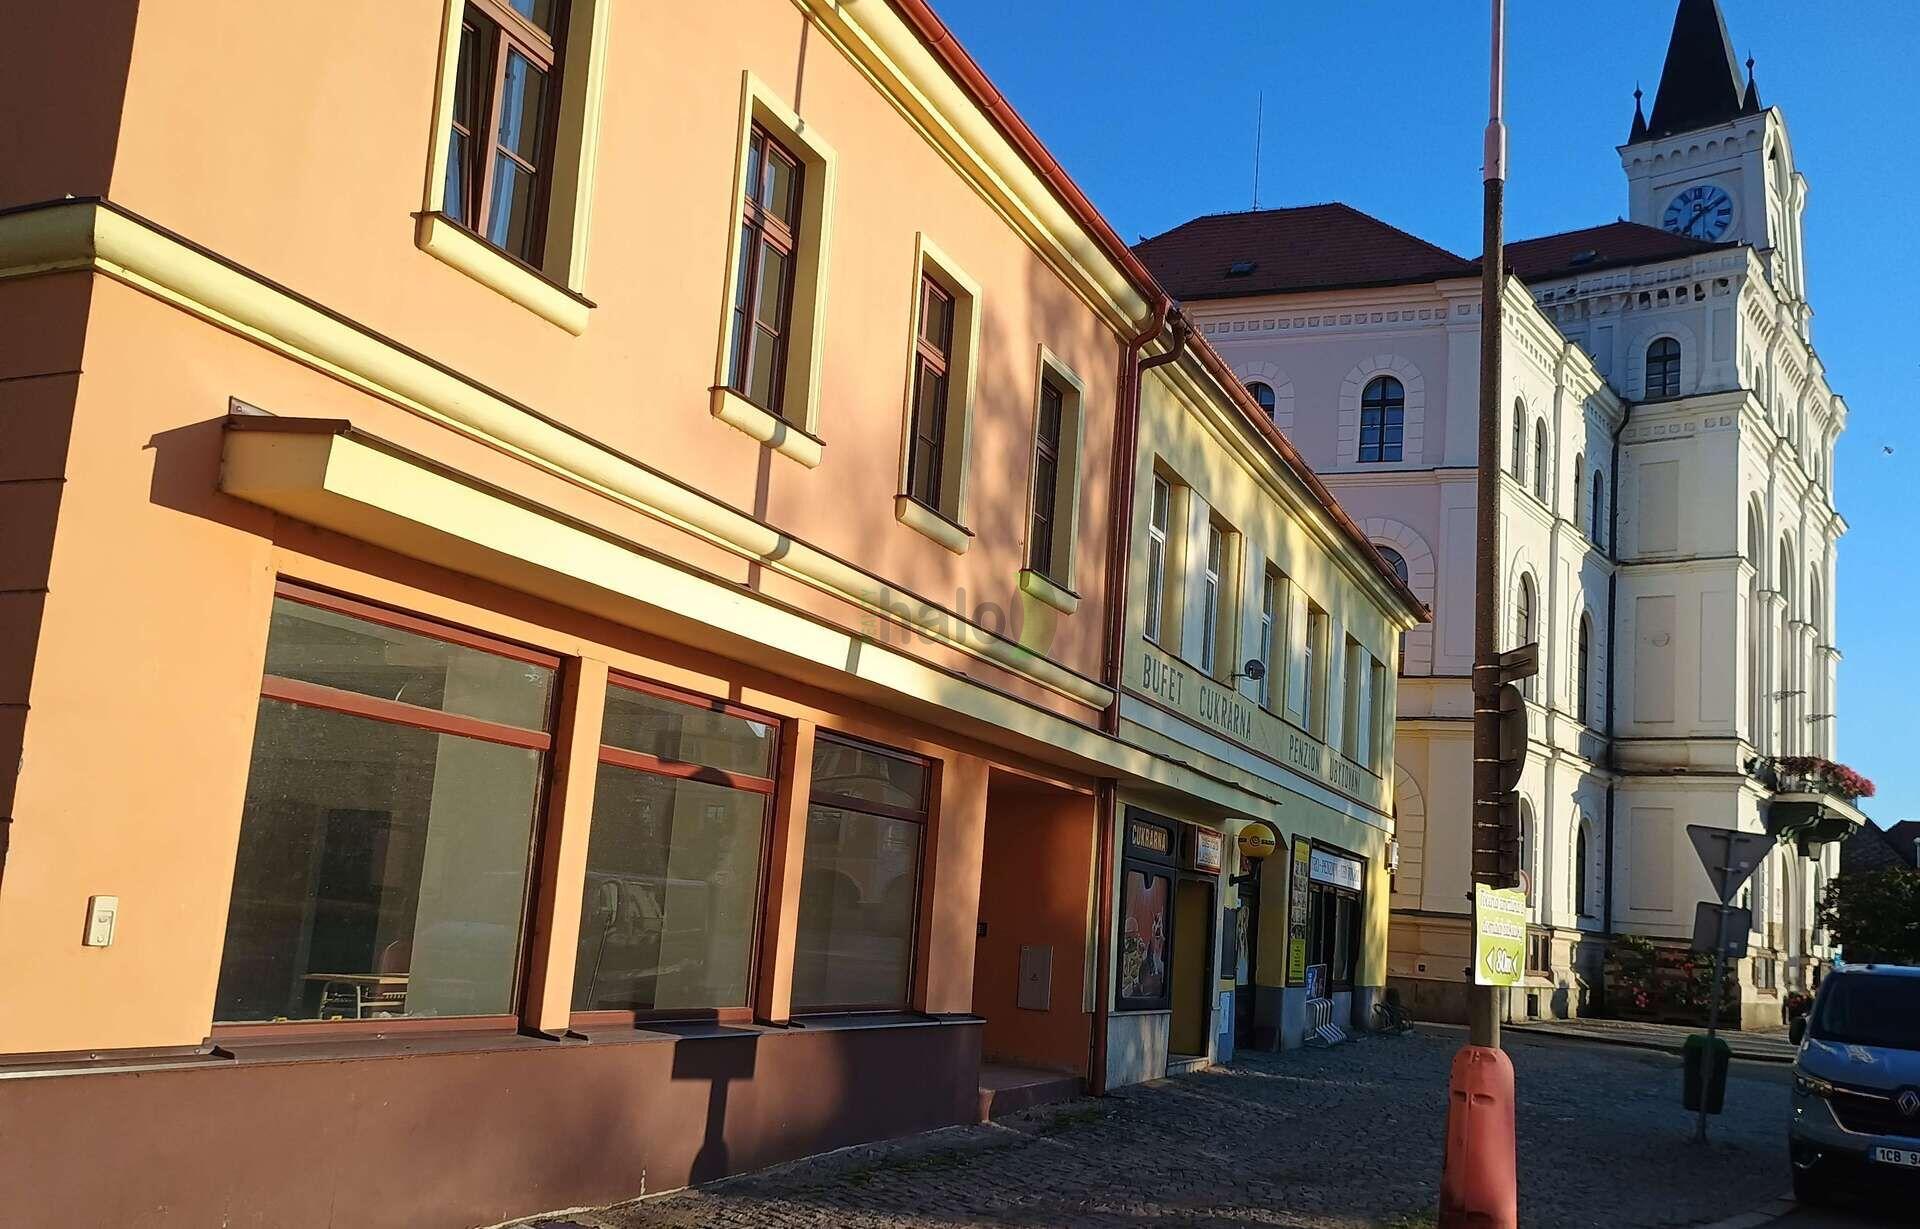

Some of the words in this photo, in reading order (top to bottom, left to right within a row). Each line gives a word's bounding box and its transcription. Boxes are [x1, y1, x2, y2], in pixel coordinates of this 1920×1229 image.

[1143, 654, 1184, 705] BUFET
[1199, 685, 1251, 742] CUKRÁRNA
[1289, 734, 1321, 775] PENZION
[1132, 824, 1168, 852] CUKRÁRNA
[1880, 1149, 1901, 1162] 1CB
[1909, 1154, 1920, 1165] 9
